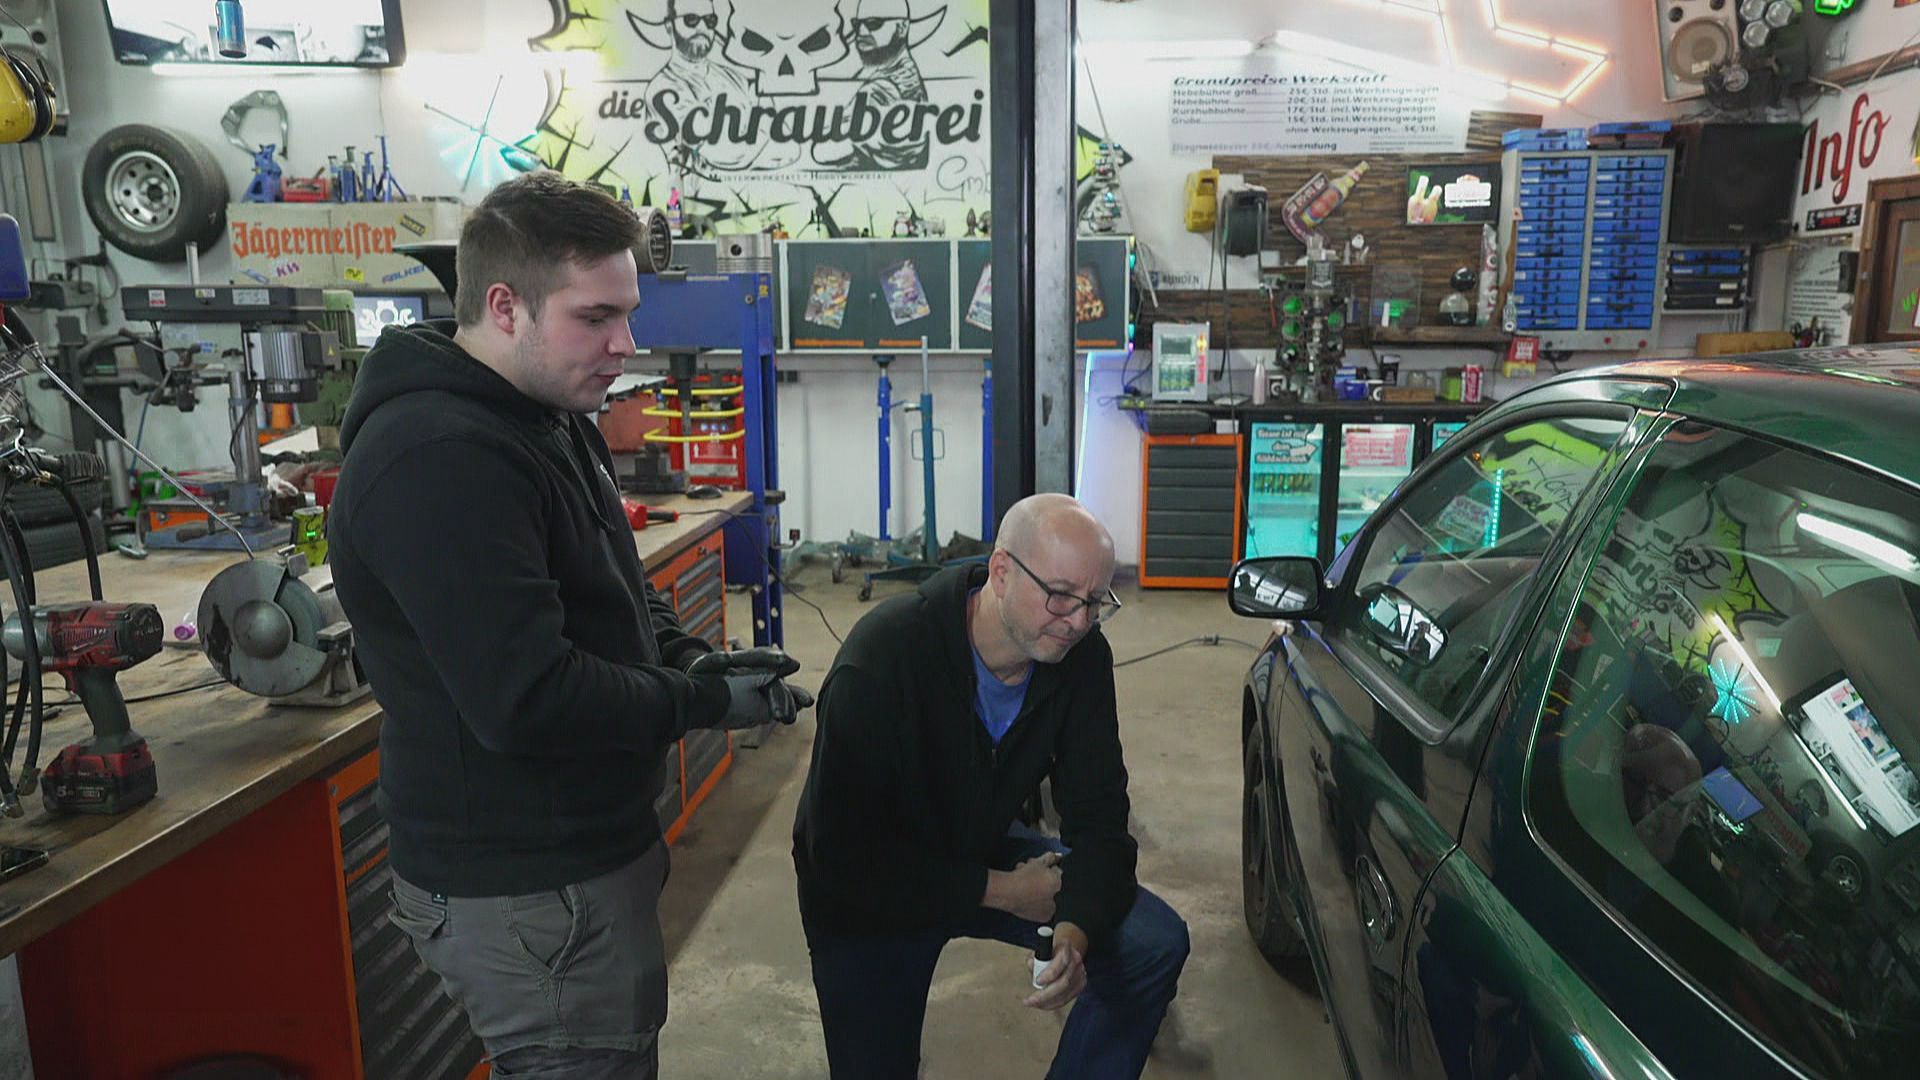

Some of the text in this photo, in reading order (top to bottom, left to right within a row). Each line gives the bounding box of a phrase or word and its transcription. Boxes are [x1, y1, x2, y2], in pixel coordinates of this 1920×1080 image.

[1174, 74, 1388, 86] Grundpreise Werkstatt
[599, 88, 985, 146] die Schrauberei
[1801, 92, 1892, 205] Info
